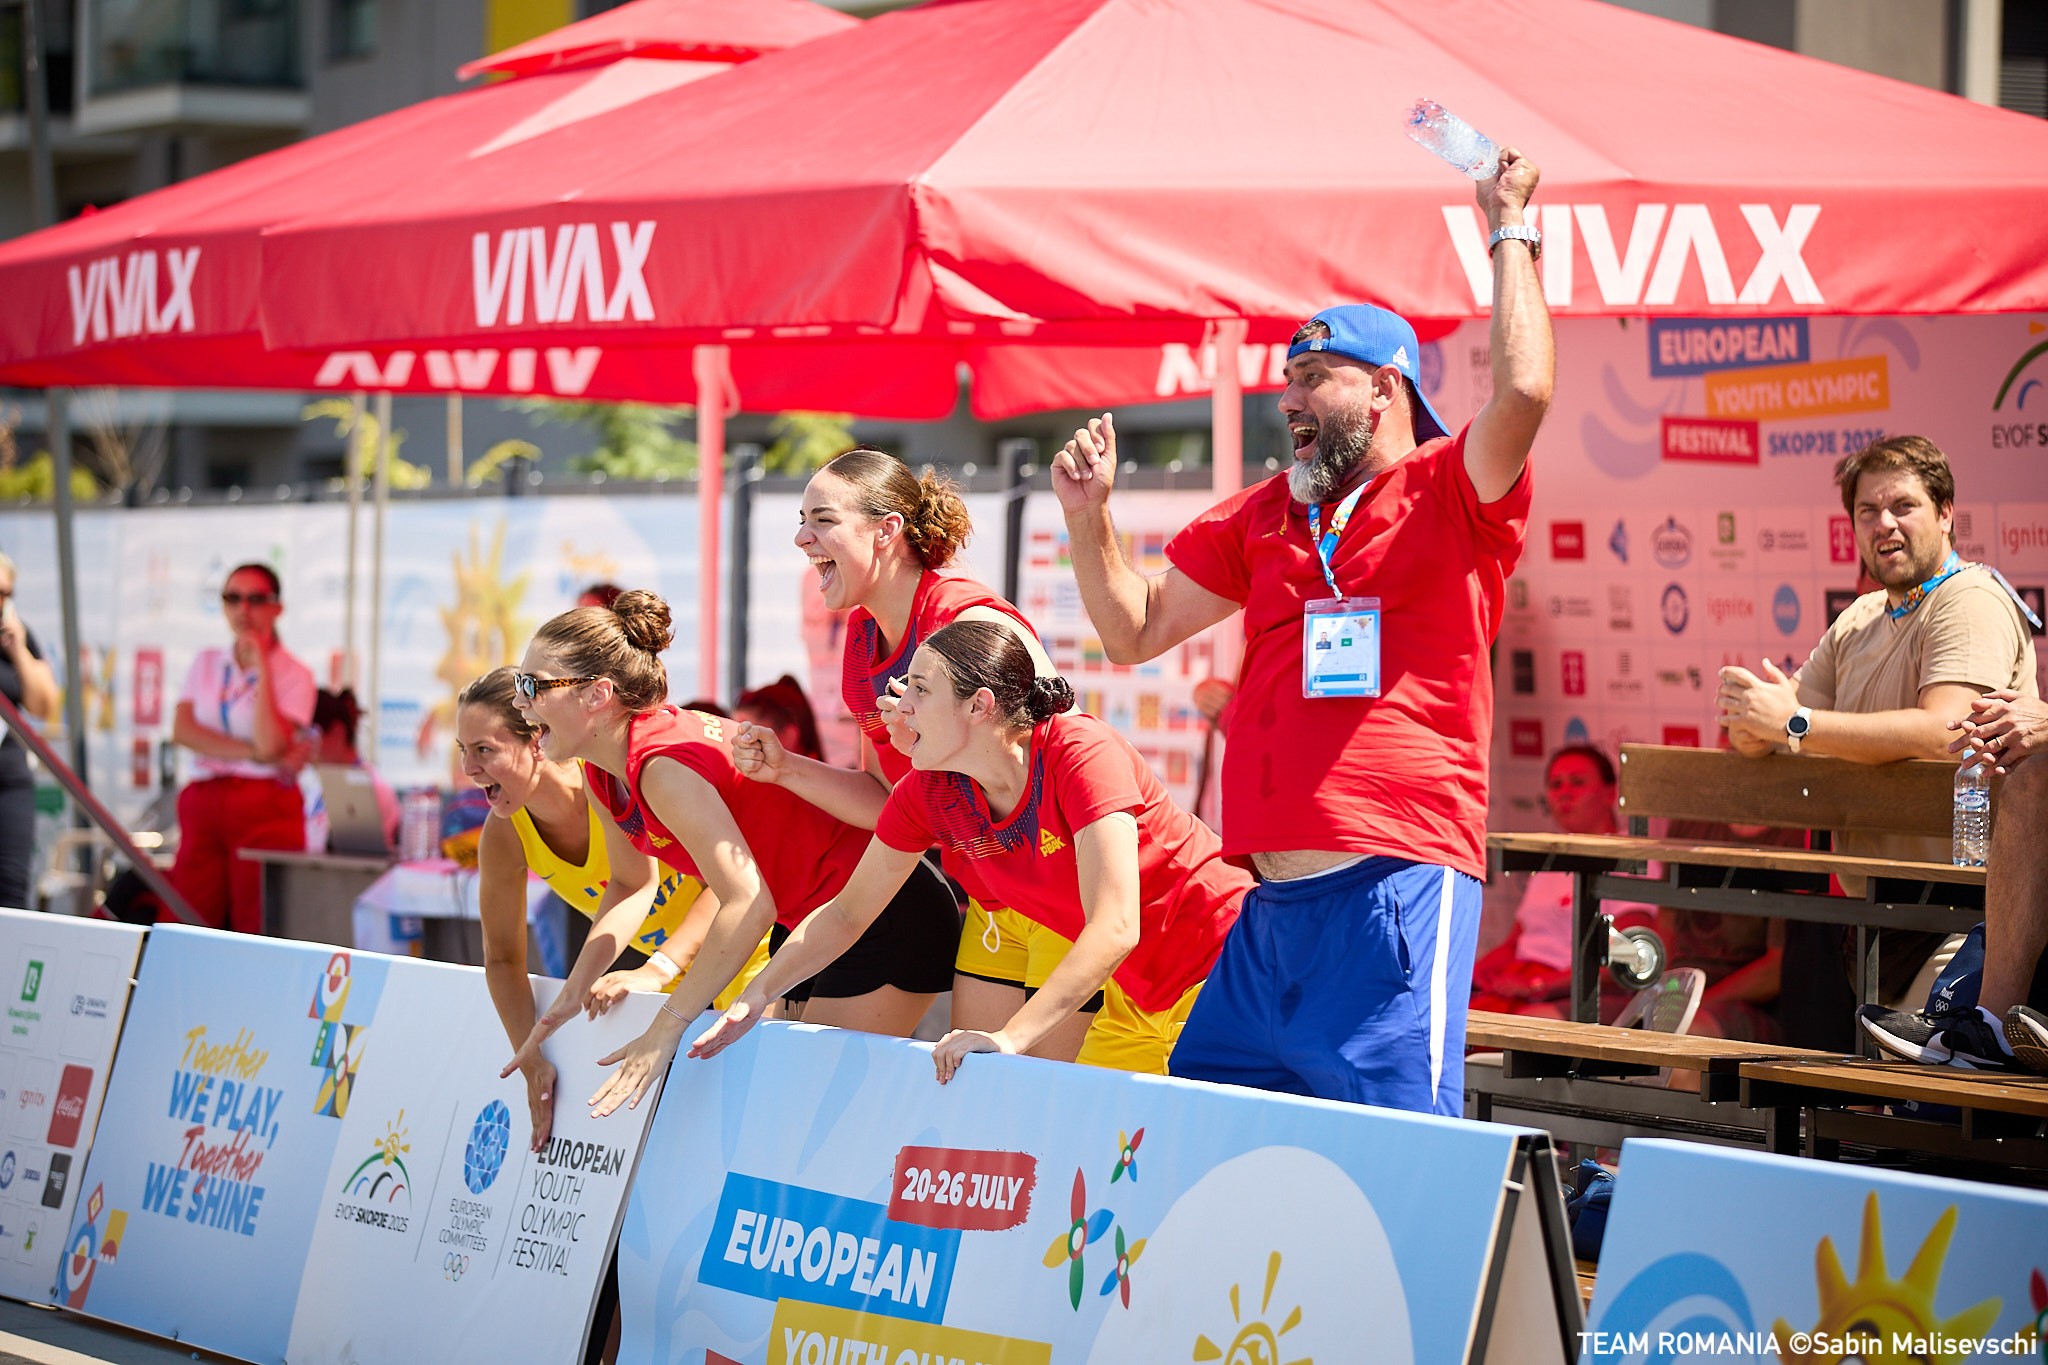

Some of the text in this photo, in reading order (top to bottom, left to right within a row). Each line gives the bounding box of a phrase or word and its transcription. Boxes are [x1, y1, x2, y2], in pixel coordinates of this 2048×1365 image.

[473, 221, 656, 327] VIVAX
[1441, 204, 1824, 306] VIVAX
[68, 247, 200, 346] VIVAX
[1658, 323, 1798, 365] EUROPEAN
[1713, 370, 1880, 413] YOUTH OLYMPIC
[1666, 425, 1753, 456] FESTIVAL
[1768, 432, 1837, 456] SKOPJE
[1992, 424, 2034, 449] EYOF
[1040, 836, 1067, 857] PEAK
[179, 1025, 269, 1092] Together
[168, 1070, 284, 1150] WE PLAY,
[177, 1125, 264, 1194] Together
[537, 1136, 626, 1176] EUROPEAN
[142, 1162, 266, 1236] WE SHINE
[532, 1169, 585, 1206] YOUTH
[901, 1167, 1025, 1211] 20-26 JULY
[335, 1202, 409, 1233] EYOF SKOPJE 2025
[450, 1198, 492, 1219] EUROPEAN
[451, 1215, 484, 1235] OLYMPIC
[521, 1204, 586, 1242] OLYMPIC
[439, 1228, 487, 1251] COMMITTEES
[508, 1236, 572, 1276] FESTIVAL
[723, 1208, 938, 1308] EUROPEAN
